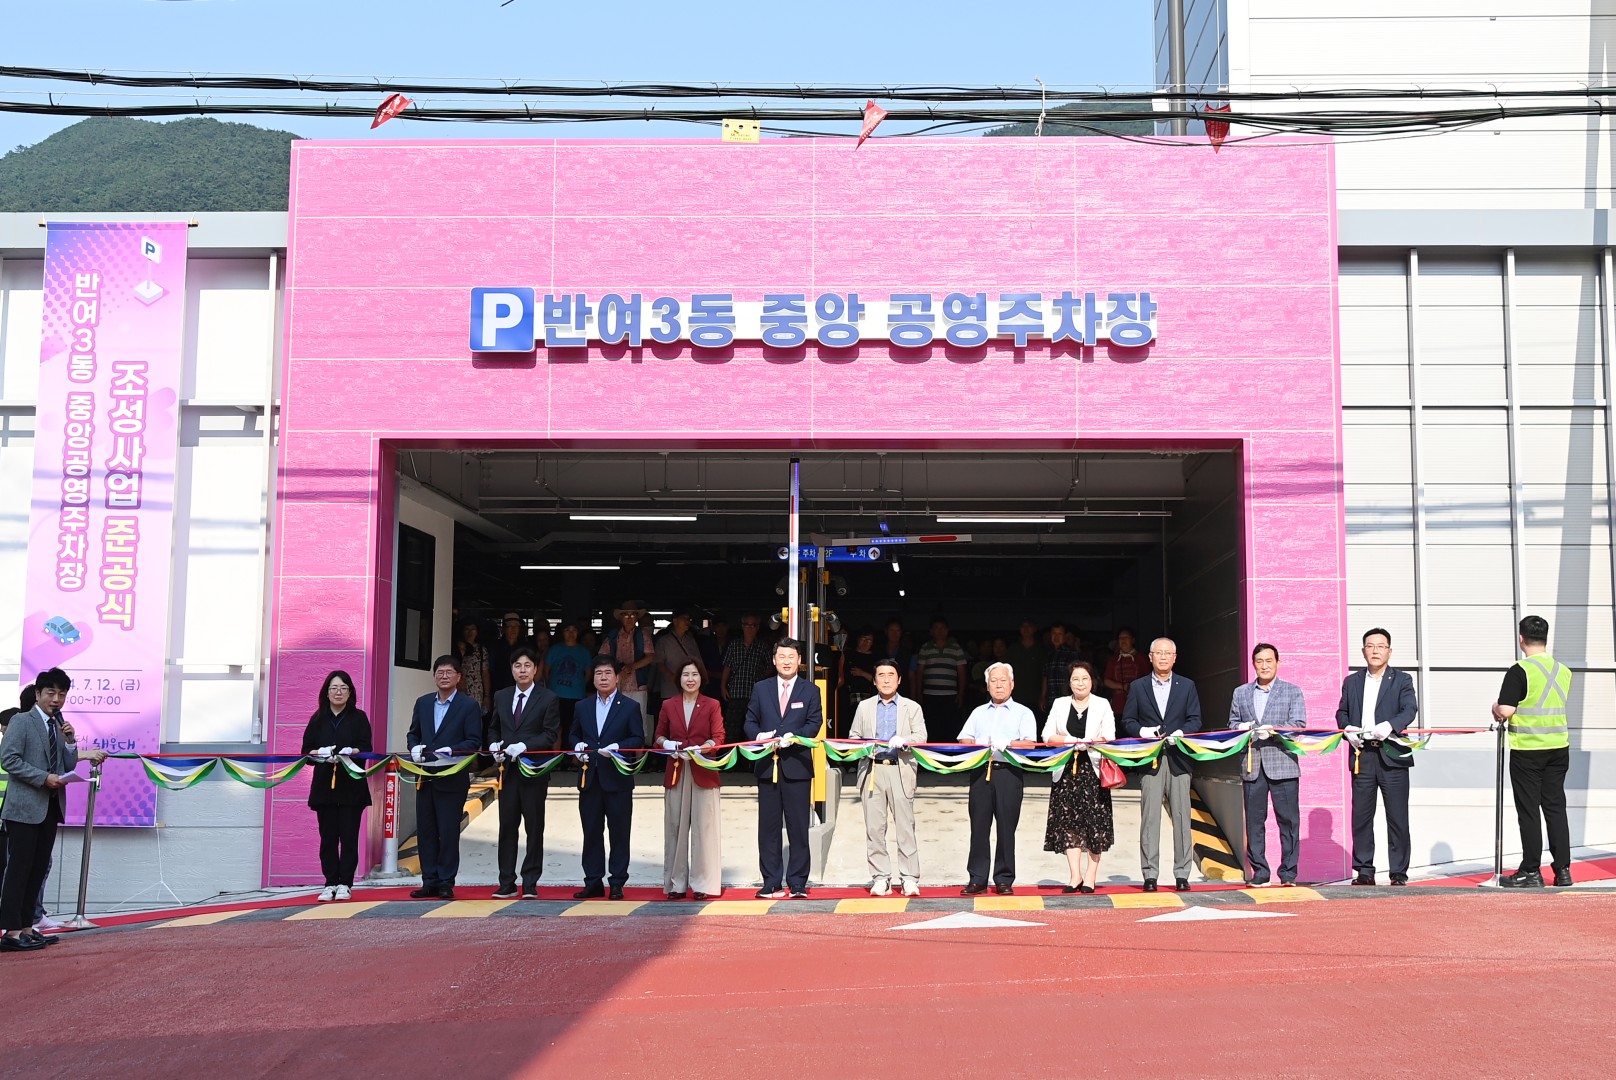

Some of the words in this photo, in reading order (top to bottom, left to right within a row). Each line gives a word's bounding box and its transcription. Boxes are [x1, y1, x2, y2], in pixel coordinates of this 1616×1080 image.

[144, 241, 156, 256] P
[70, 271, 100, 381] 반여3동
[481, 292, 525, 347] P
[543, 293, 736, 347] 반여3동
[760, 293, 866, 347] 중앙
[887, 291, 1157, 347] 공영주차장
[108, 362, 146, 507] 조성사업
[59, 394, 93, 590] 중앙공영주차장
[100, 518, 136, 628] 준공식
[120, 679, 141, 691] (금)
